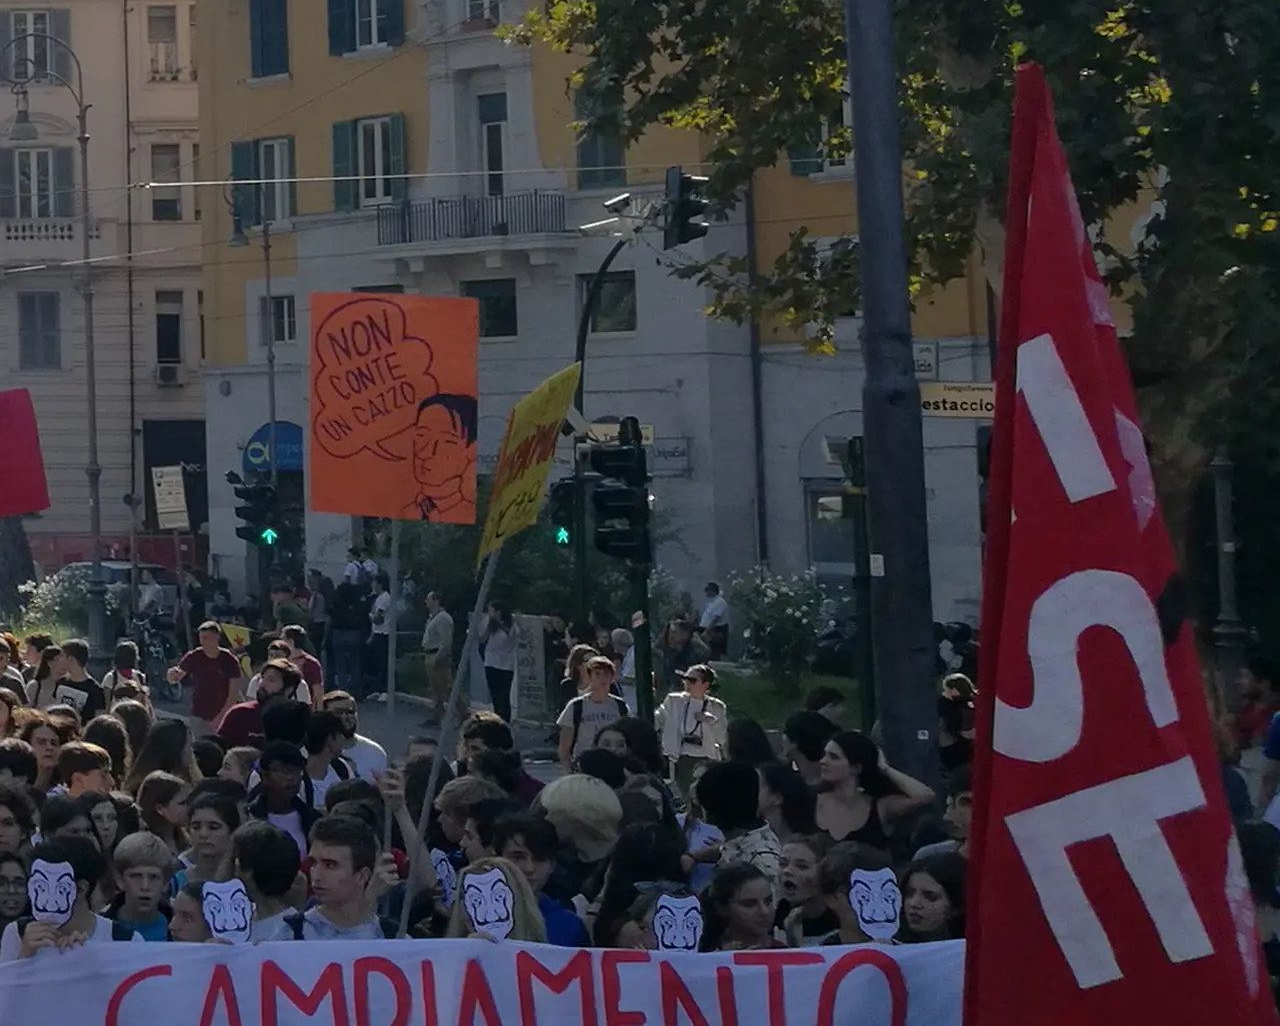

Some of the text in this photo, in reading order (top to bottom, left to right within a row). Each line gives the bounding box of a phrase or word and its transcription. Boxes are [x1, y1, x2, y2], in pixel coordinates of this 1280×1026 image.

[327, 309, 394, 366] NON
[329, 352, 407, 400] CONTE
[321, 381, 416, 442] UN CAZZO
[922, 398, 995, 412] estaccio
